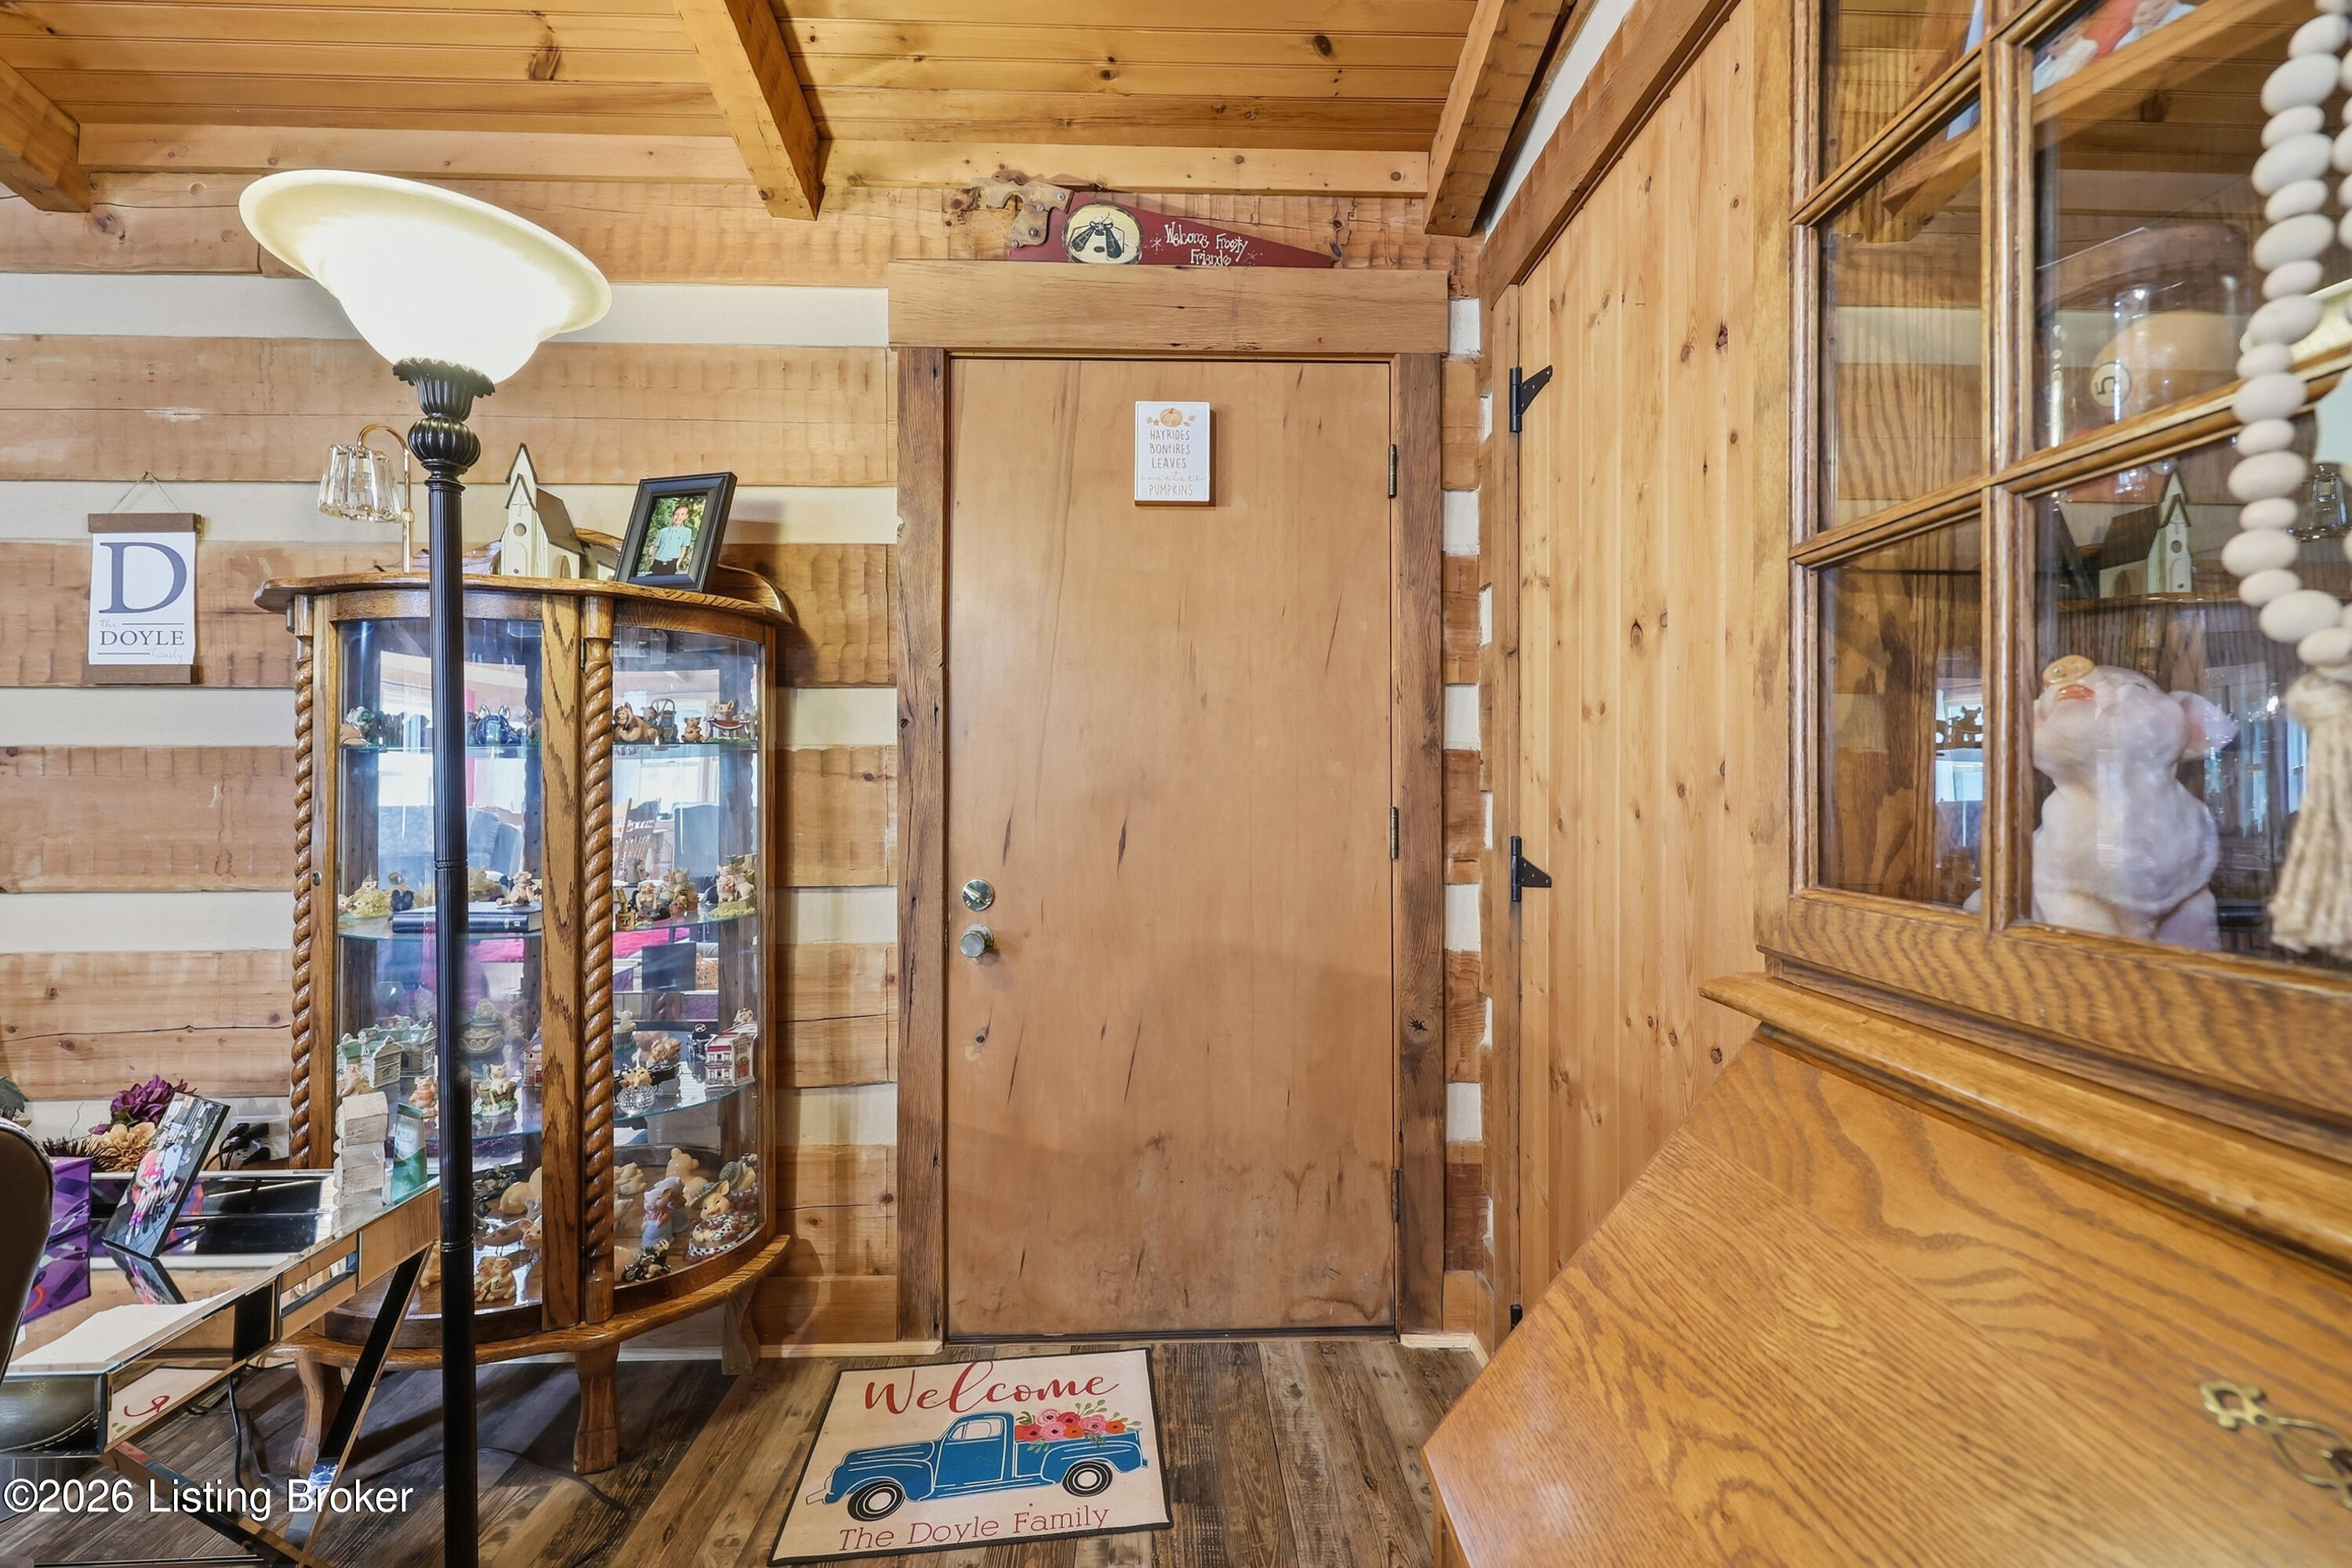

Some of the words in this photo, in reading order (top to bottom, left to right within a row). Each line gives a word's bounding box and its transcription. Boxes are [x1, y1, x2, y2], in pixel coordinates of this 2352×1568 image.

[1163, 221, 1210, 249] Welcome
[1215, 233, 1249, 263] Frosty
[1190, 249, 1232, 266] Friends
[1149, 430, 1190, 441] HAYRIDES
[1149, 443, 1191, 455] BONFIRES
[1152, 458, 1187, 469] LEAVES
[1149, 484, 1193, 496] PUMPKINS
[99, 542, 187, 614] D
[100, 630, 185, 645] DOYLE
[865, 1361, 1119, 1414] Welcome
[839, 1527, 895, 1552] The
[907, 1516, 1000, 1544] Doyle
[1013, 1504, 1110, 1534] Family
